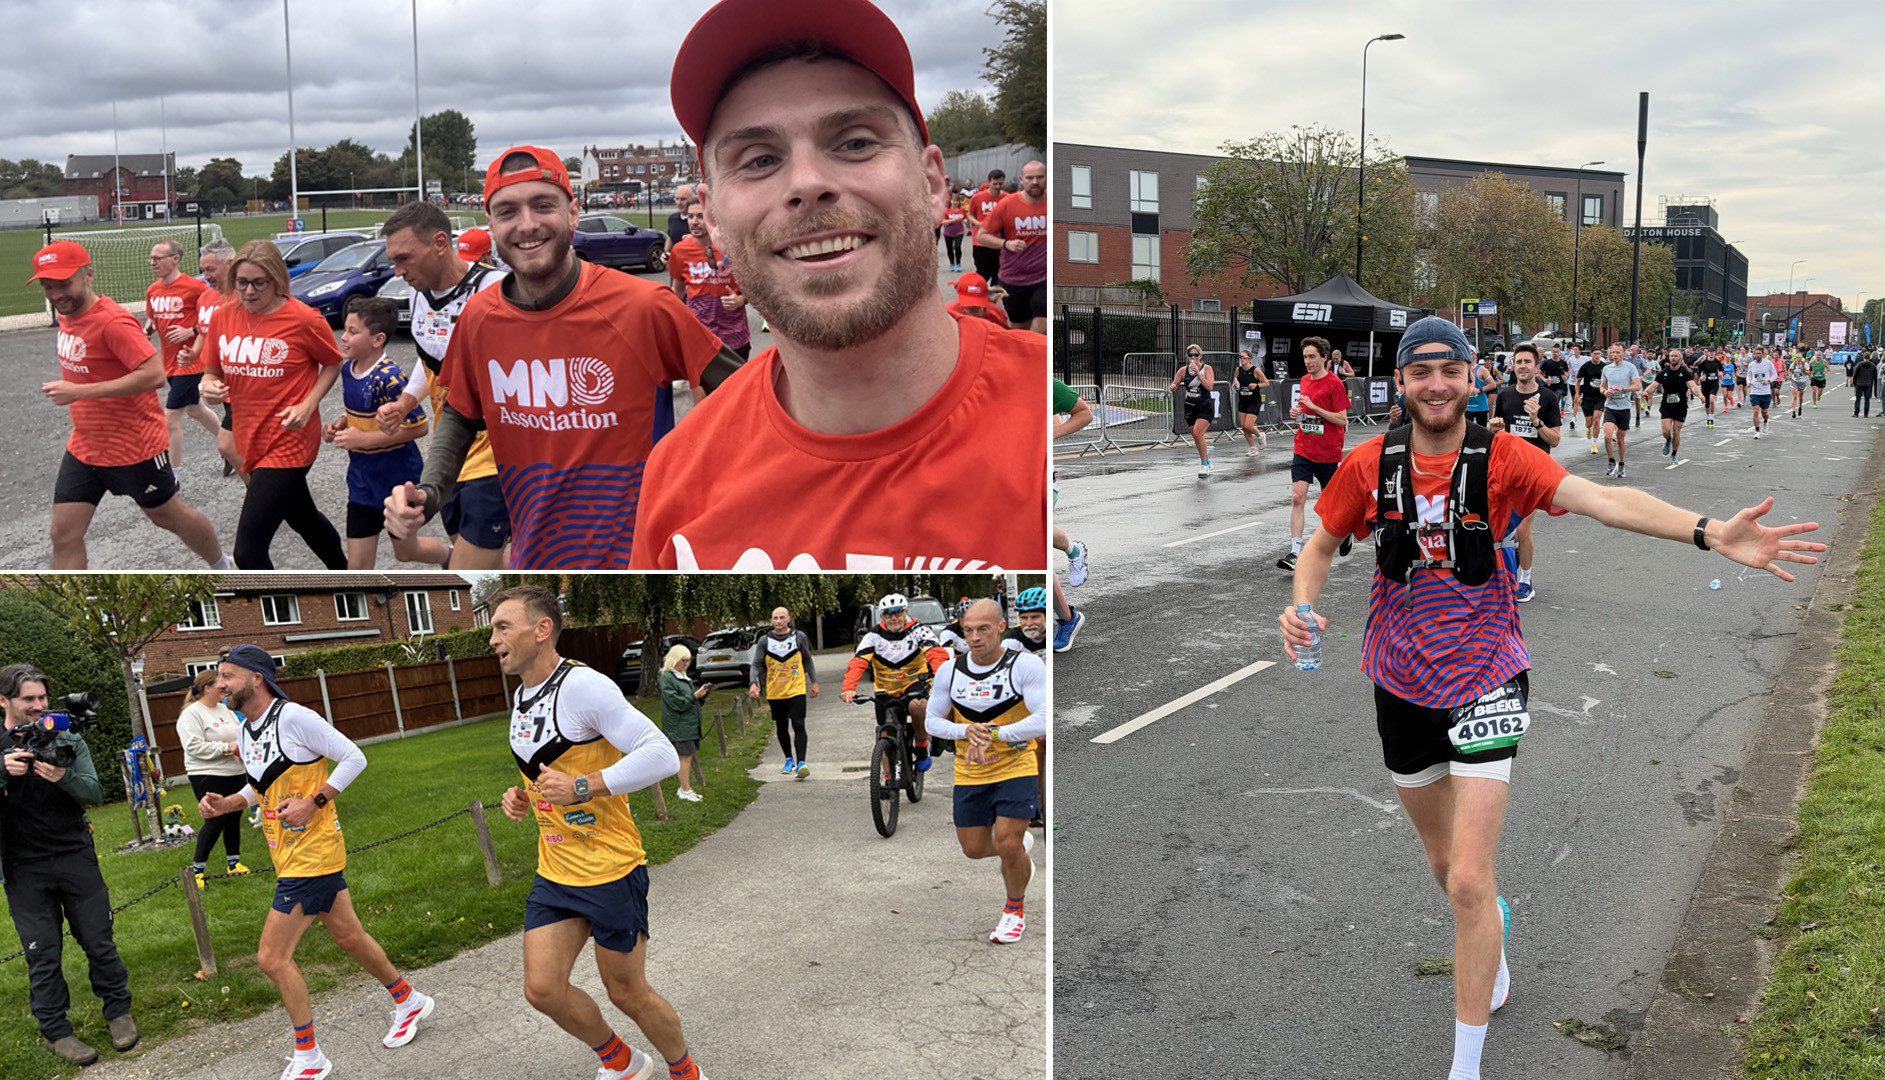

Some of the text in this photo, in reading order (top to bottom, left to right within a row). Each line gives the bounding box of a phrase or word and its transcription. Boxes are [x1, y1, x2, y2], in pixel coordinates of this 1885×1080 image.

[1014, 215, 1046, 230] MN
[1666, 228, 1702, 237] HOUSE
[218, 333, 289, 366] MND
[488, 356, 615, 408] MND
[500, 405, 619, 432] Association
[1515, 426, 1532, 434] 1875
[992, 684, 1004, 700] 7
[1474, 699, 1523, 717] BEEKE
[531, 717, 547, 743] 7
[1458, 716, 1524, 741] 40162
[263, 741, 271, 763] 7
